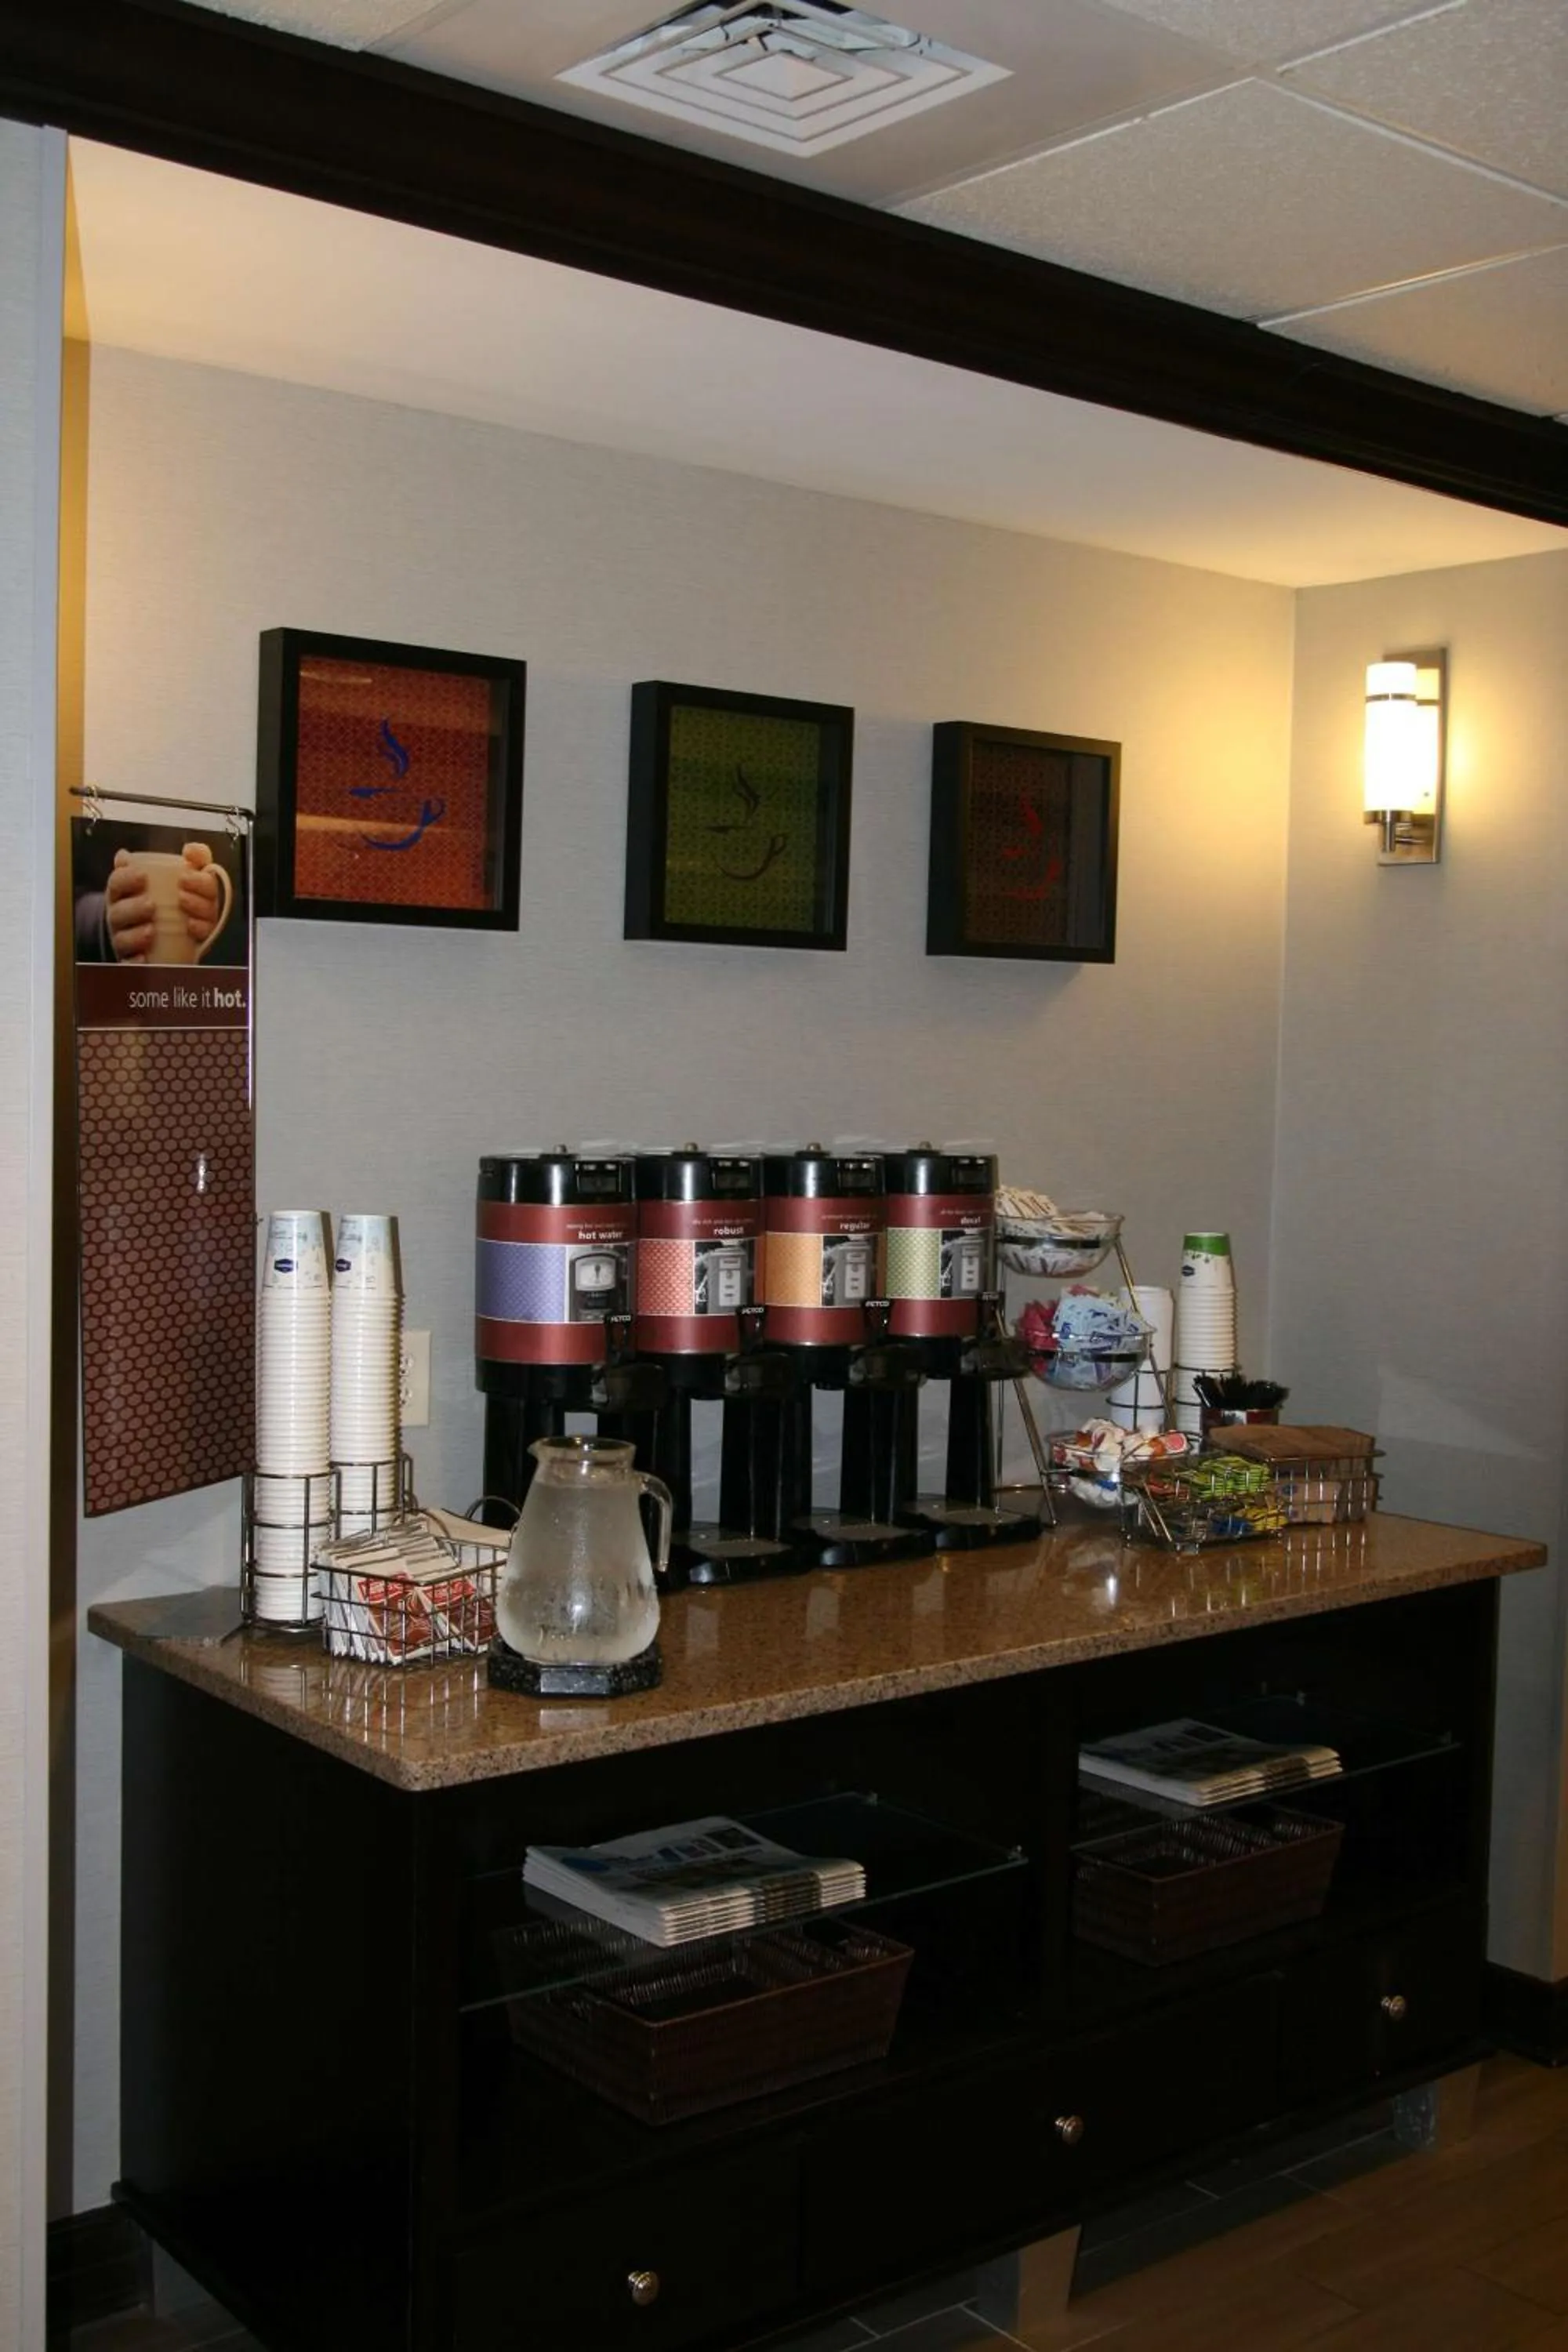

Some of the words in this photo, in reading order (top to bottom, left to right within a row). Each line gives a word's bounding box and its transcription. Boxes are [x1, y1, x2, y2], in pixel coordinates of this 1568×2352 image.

[129, 991, 169, 1008] some
[173, 986, 198, 1008] like
[201, 986, 211, 1008] it
[213, 987, 247, 1008] hot.
[713, 1226, 744, 1236] robust
[840, 1221, 870, 1232] regular
[578, 1230, 596, 1240] hot
[598, 1231, 623, 1240] water
